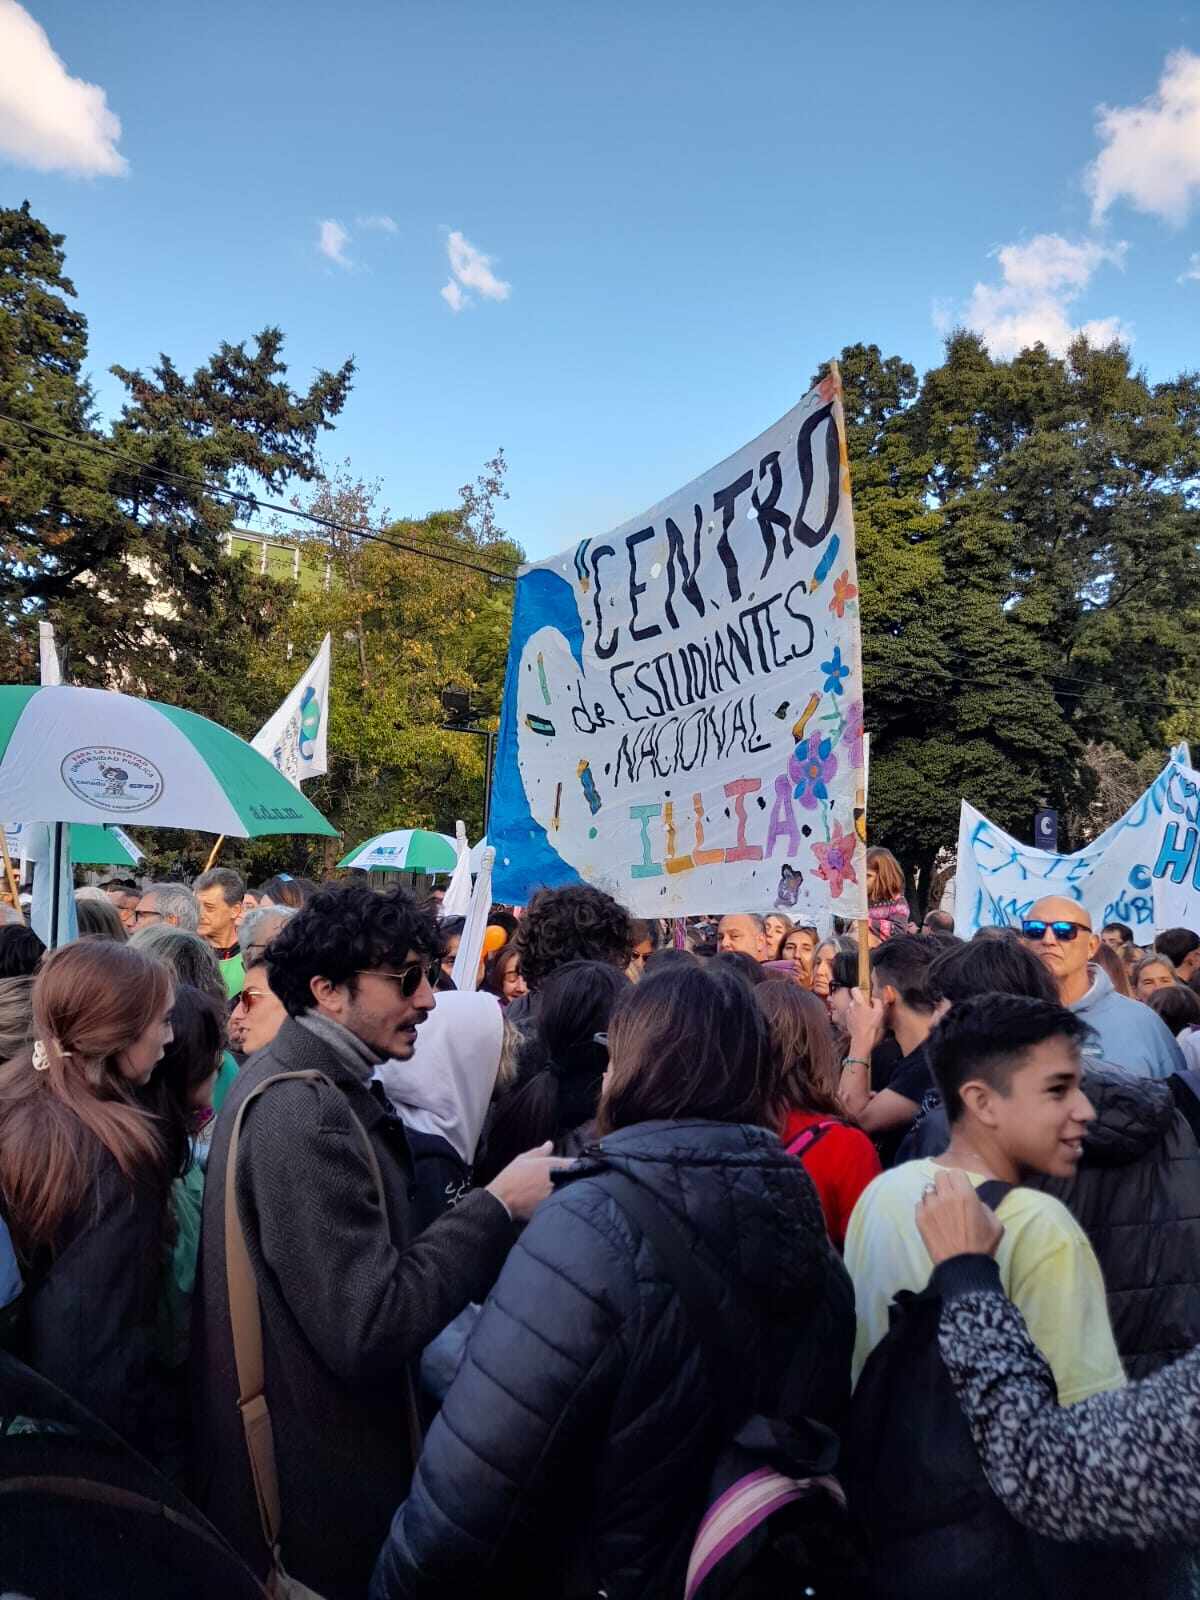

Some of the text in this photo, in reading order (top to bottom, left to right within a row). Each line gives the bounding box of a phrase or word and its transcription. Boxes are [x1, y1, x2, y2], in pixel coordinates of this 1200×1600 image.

[591, 402, 840, 660] CENTRO
[572, 581, 814, 734] de ESTUDIANTES
[614, 694, 771, 788] NACIONAL
[630, 774, 800, 879] ILLIA
